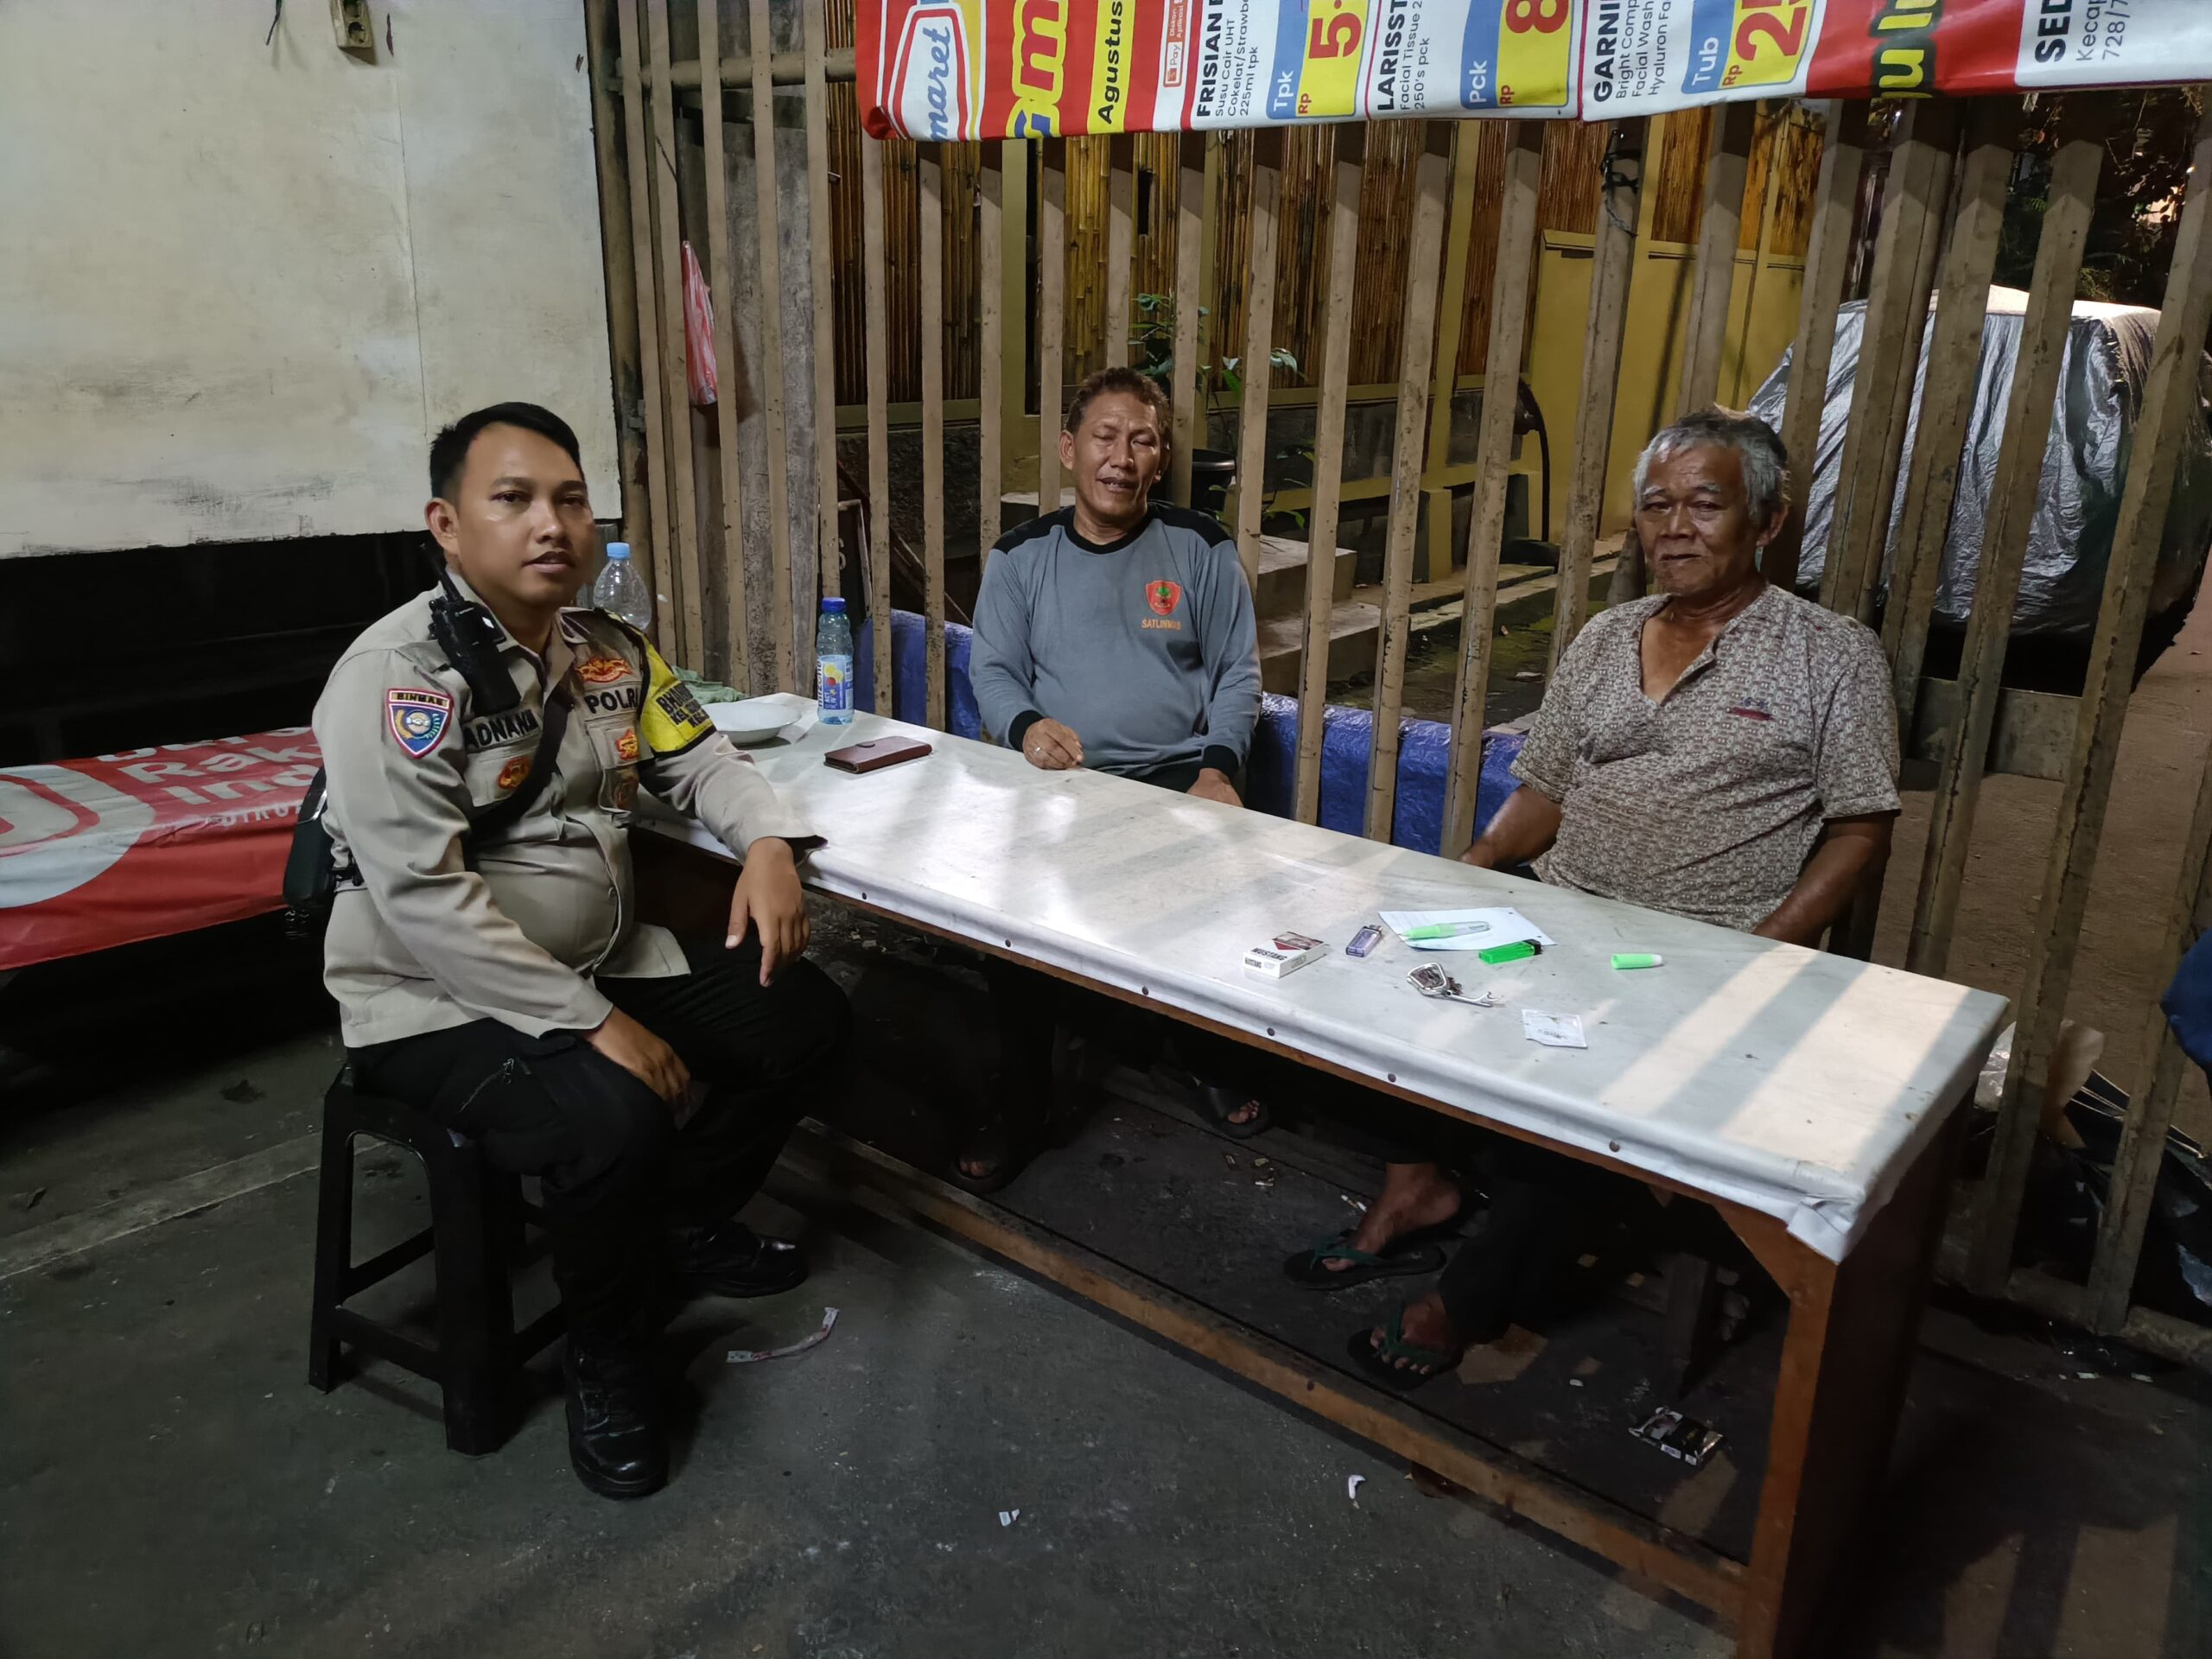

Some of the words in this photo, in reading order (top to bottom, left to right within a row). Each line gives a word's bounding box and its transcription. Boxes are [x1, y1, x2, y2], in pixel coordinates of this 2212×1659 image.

[1225, 19, 1236, 46] UHT
[1402, 14, 1421, 60] Tissue
[1637, 0, 1654, 48] Wash
[1098, 0, 1123, 124] Agustus
[1169, 44, 1181, 66] Pay
[1196, 13, 1223, 118] FRISIAN
[1221, 49, 1232, 79] Cair
[1418, 37, 1430, 66] pck
[1592, 0, 1621, 103] GARNI
[1648, 23, 1667, 96] Hyaluron
[1691, 36, 1719, 86] Tub
[1239, 73, 1255, 117] 225ml
[1248, 47, 1260, 69] tpk
[1273, 69, 1294, 112] Tpk
[1400, 66, 1411, 111] Facial
[1414, 70, 1426, 111] 250's
[1469, 60, 1488, 104] Pck
[1499, 85, 1516, 105] Rp
[1615, 53, 1634, 99] Bright
[1631, 51, 1649, 97] Facial
[1722, 64, 1743, 86] Rp
[1215, 84, 1229, 117] Susu
[1297, 92, 1313, 115] Rp
[584, 688, 639, 715] POLRI
[1251, 947, 1288, 961] MUSTANG
